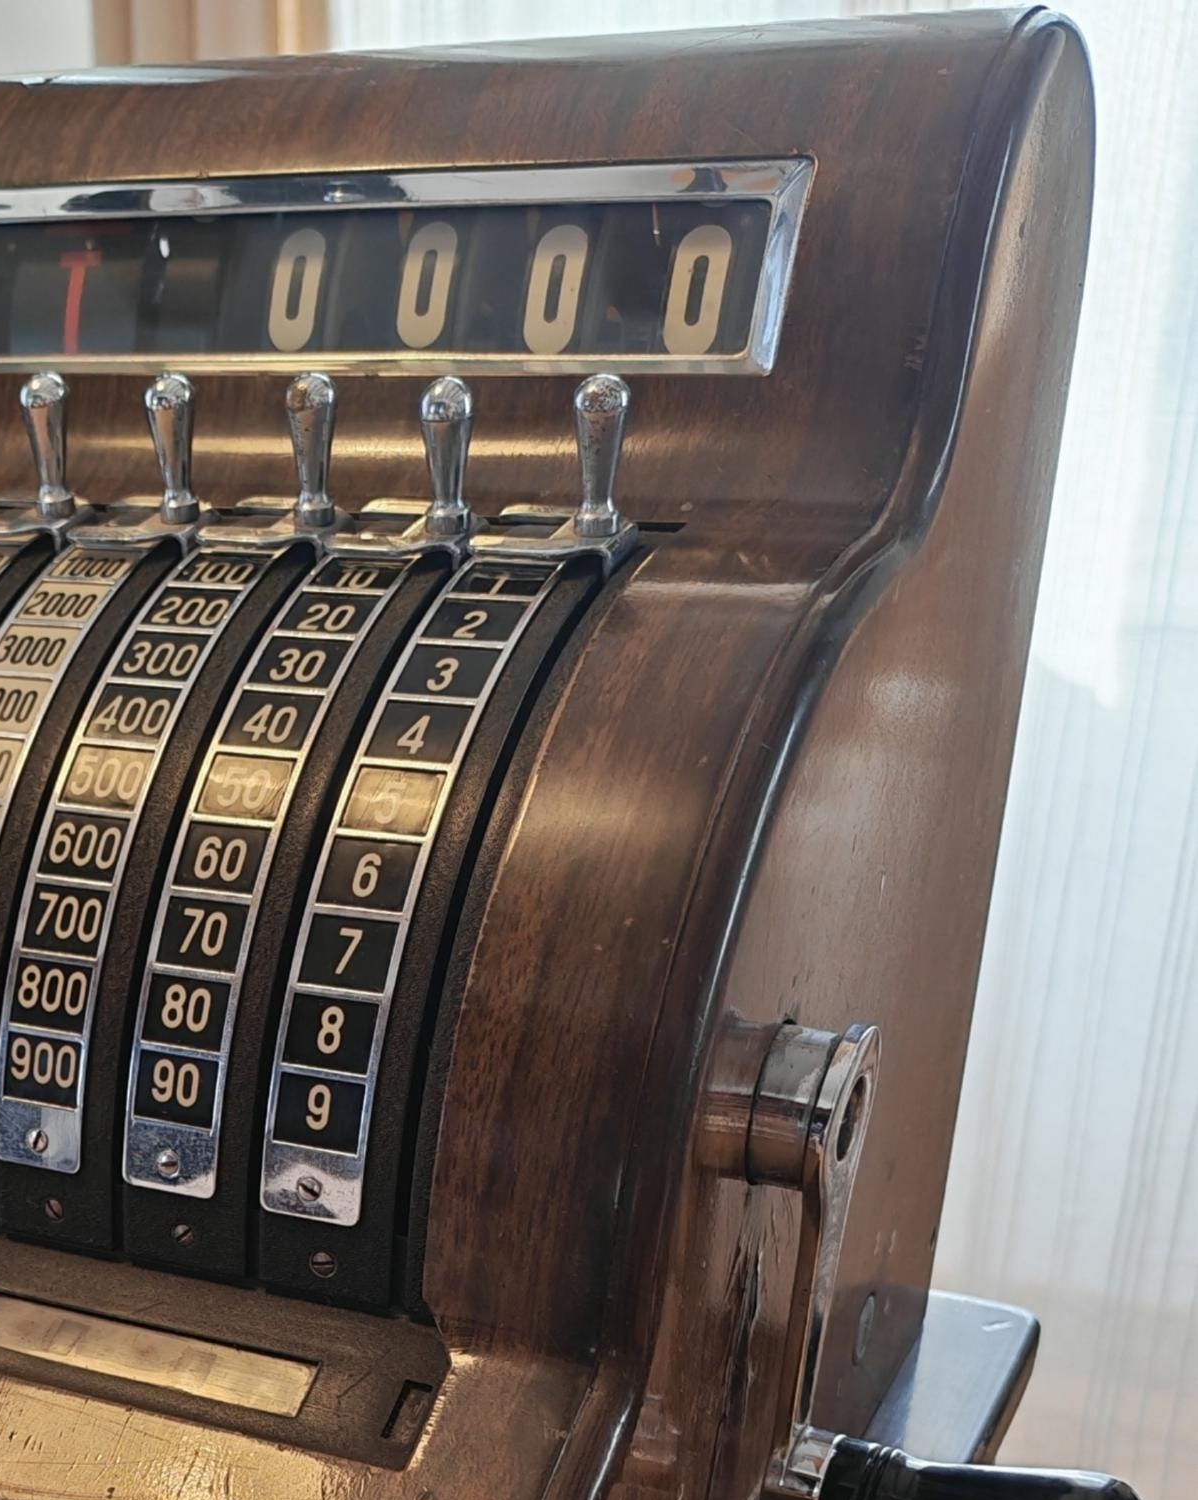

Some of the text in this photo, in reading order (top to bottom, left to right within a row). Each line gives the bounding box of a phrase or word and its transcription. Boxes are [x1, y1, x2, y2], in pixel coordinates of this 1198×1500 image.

[269, 229, 326, 351] 0
[397, 222, 457, 348] 0
[523, 224, 588, 354] 0
[663, 224, 733, 354] 0
[58, 556, 127, 578] 1000
[187, 562, 257, 584] 100
[336, 569, 377, 589] 10
[23, 592, 98, 618] 2000
[151, 597, 229, 625] 200
[297, 604, 356, 632] 20
[453, 610, 488, 639] 2
[122, 641, 199, 677] 300
[269, 648, 326, 683] 30
[426, 657, 459, 692] 3
[94, 695, 171, 735] 400
[243, 704, 298, 743] 40
[397, 715, 431, 755] 4
[70, 754, 144, 800] 500
[216, 767, 273, 809] 50
[374, 780, 408, 824] 5
[49, 822, 121, 870] 600
[193, 836, 247, 881] 60
[351, 852, 382, 897] 6
[35, 892, 103, 943] 700
[179, 908, 228, 956] 70
[335, 928, 363, 975] 7
[18, 964, 87, 1016] 800
[161, 984, 212, 1032] 80
[316, 1005, 345, 1054] 8
[11, 1037, 77, 1089] 900
[151, 1058, 200, 1107] 90
[305, 1084, 332, 1131] 9
